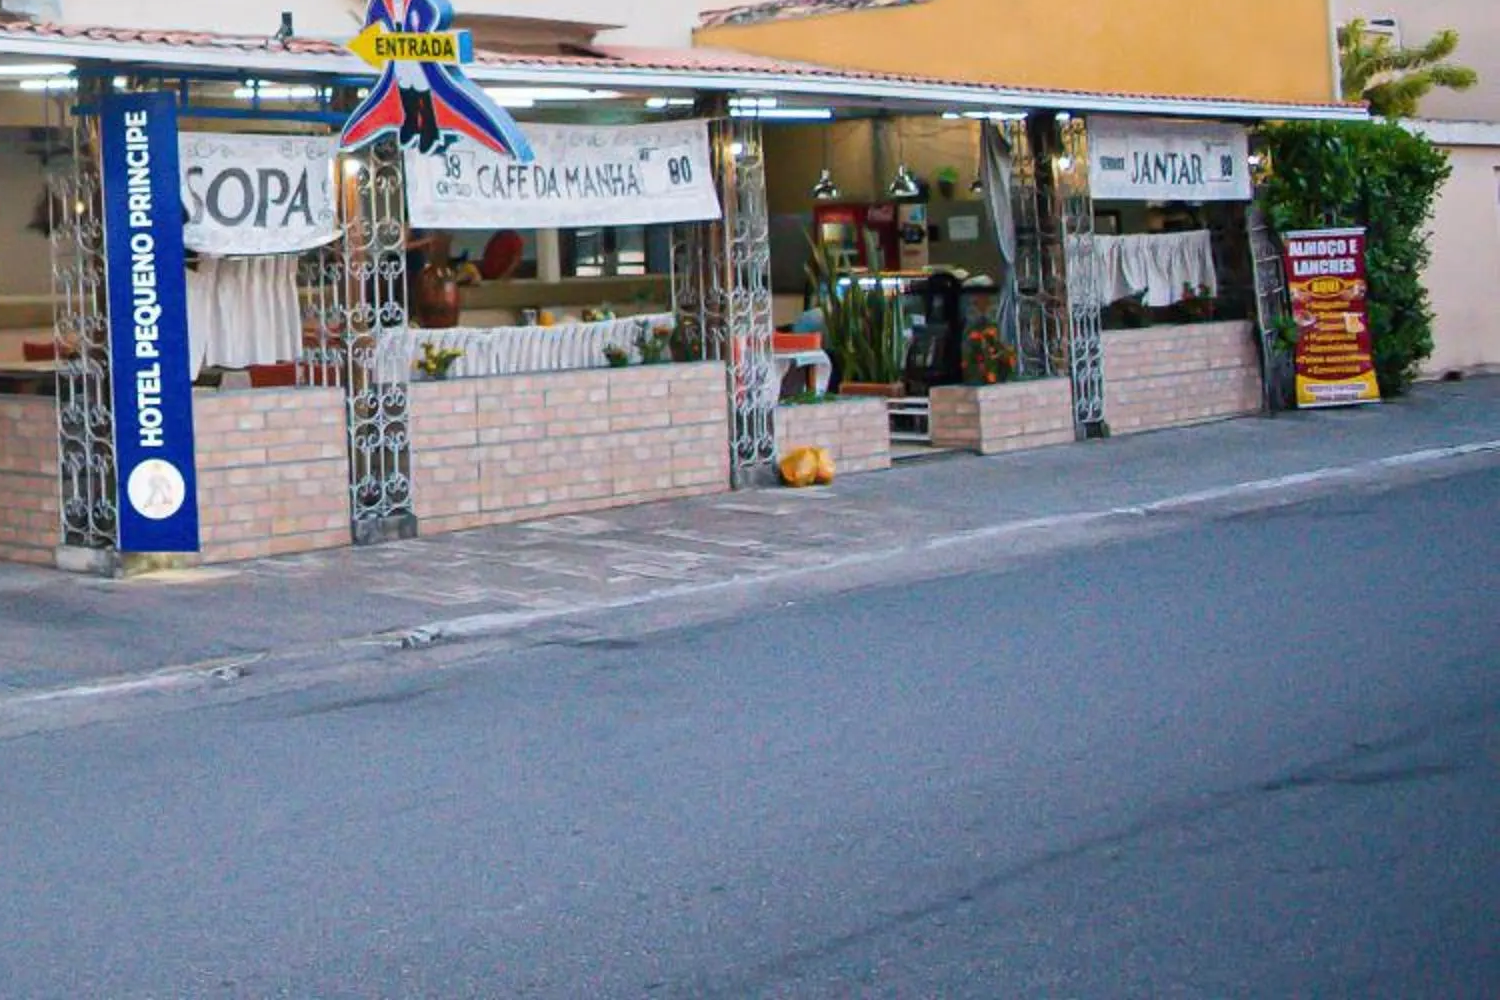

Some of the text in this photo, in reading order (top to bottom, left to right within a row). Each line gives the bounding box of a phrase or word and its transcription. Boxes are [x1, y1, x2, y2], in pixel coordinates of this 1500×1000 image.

[374, 37, 455, 57] ENTRADA
[533, 165, 561, 199] DA
[1131, 151, 1205, 184] JANTAR
[187, 165, 316, 228] SOPA
[1348, 238, 1359, 254] E
[124, 109, 165, 448] HOTEL PEQUENO PRINCIPE
